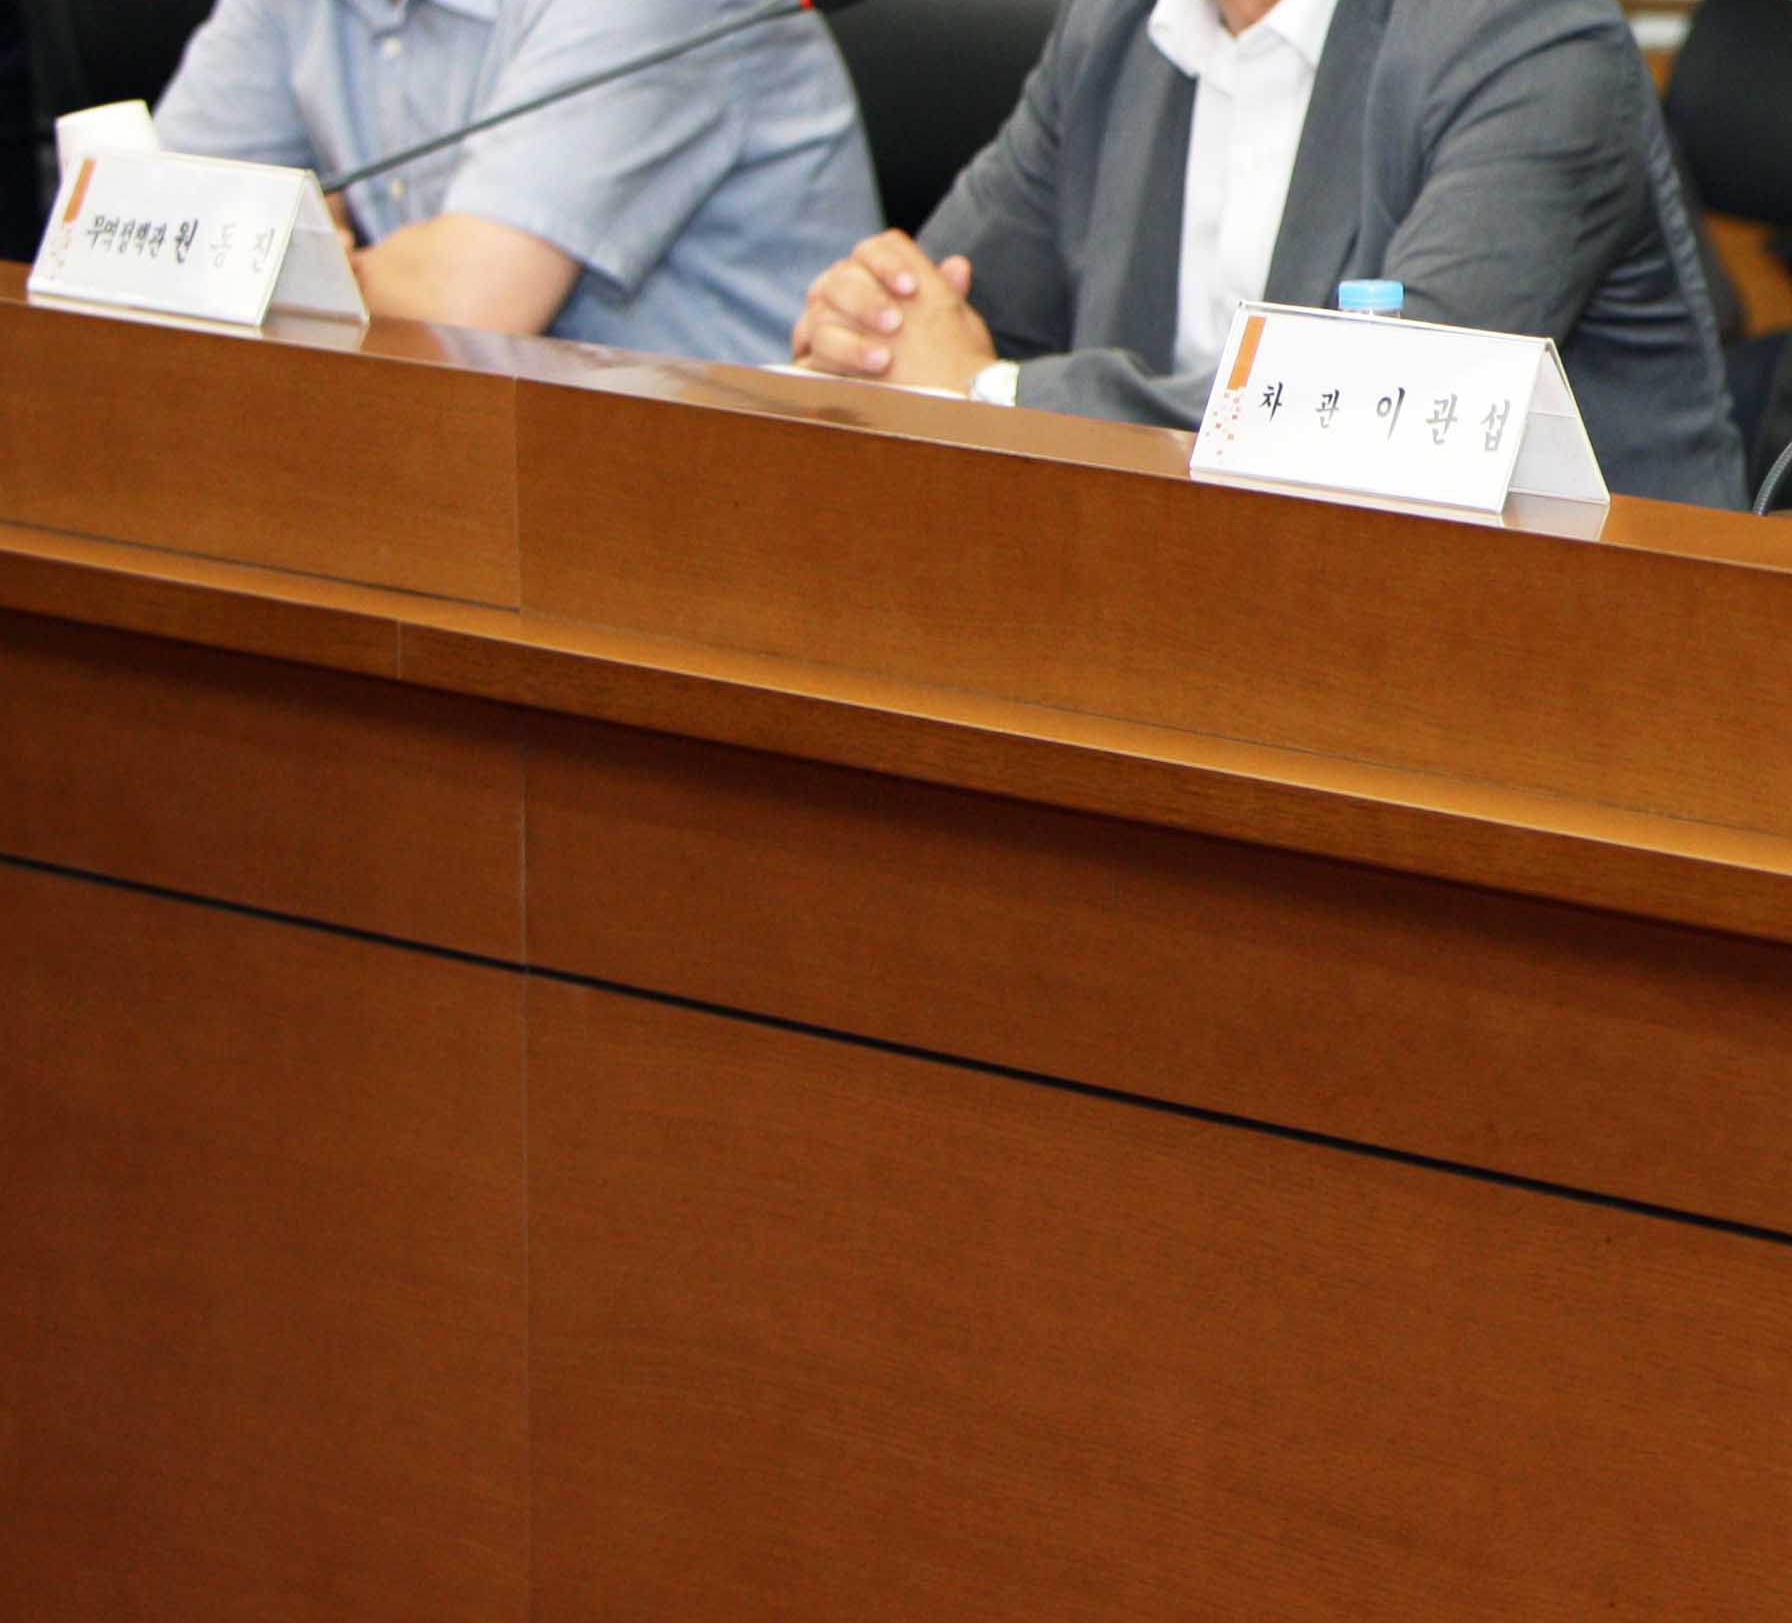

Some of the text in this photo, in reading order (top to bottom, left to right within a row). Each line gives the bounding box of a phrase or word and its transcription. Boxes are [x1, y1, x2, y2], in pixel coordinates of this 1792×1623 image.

[1257, 381, 1511, 453] 차 관 이 관 섭
